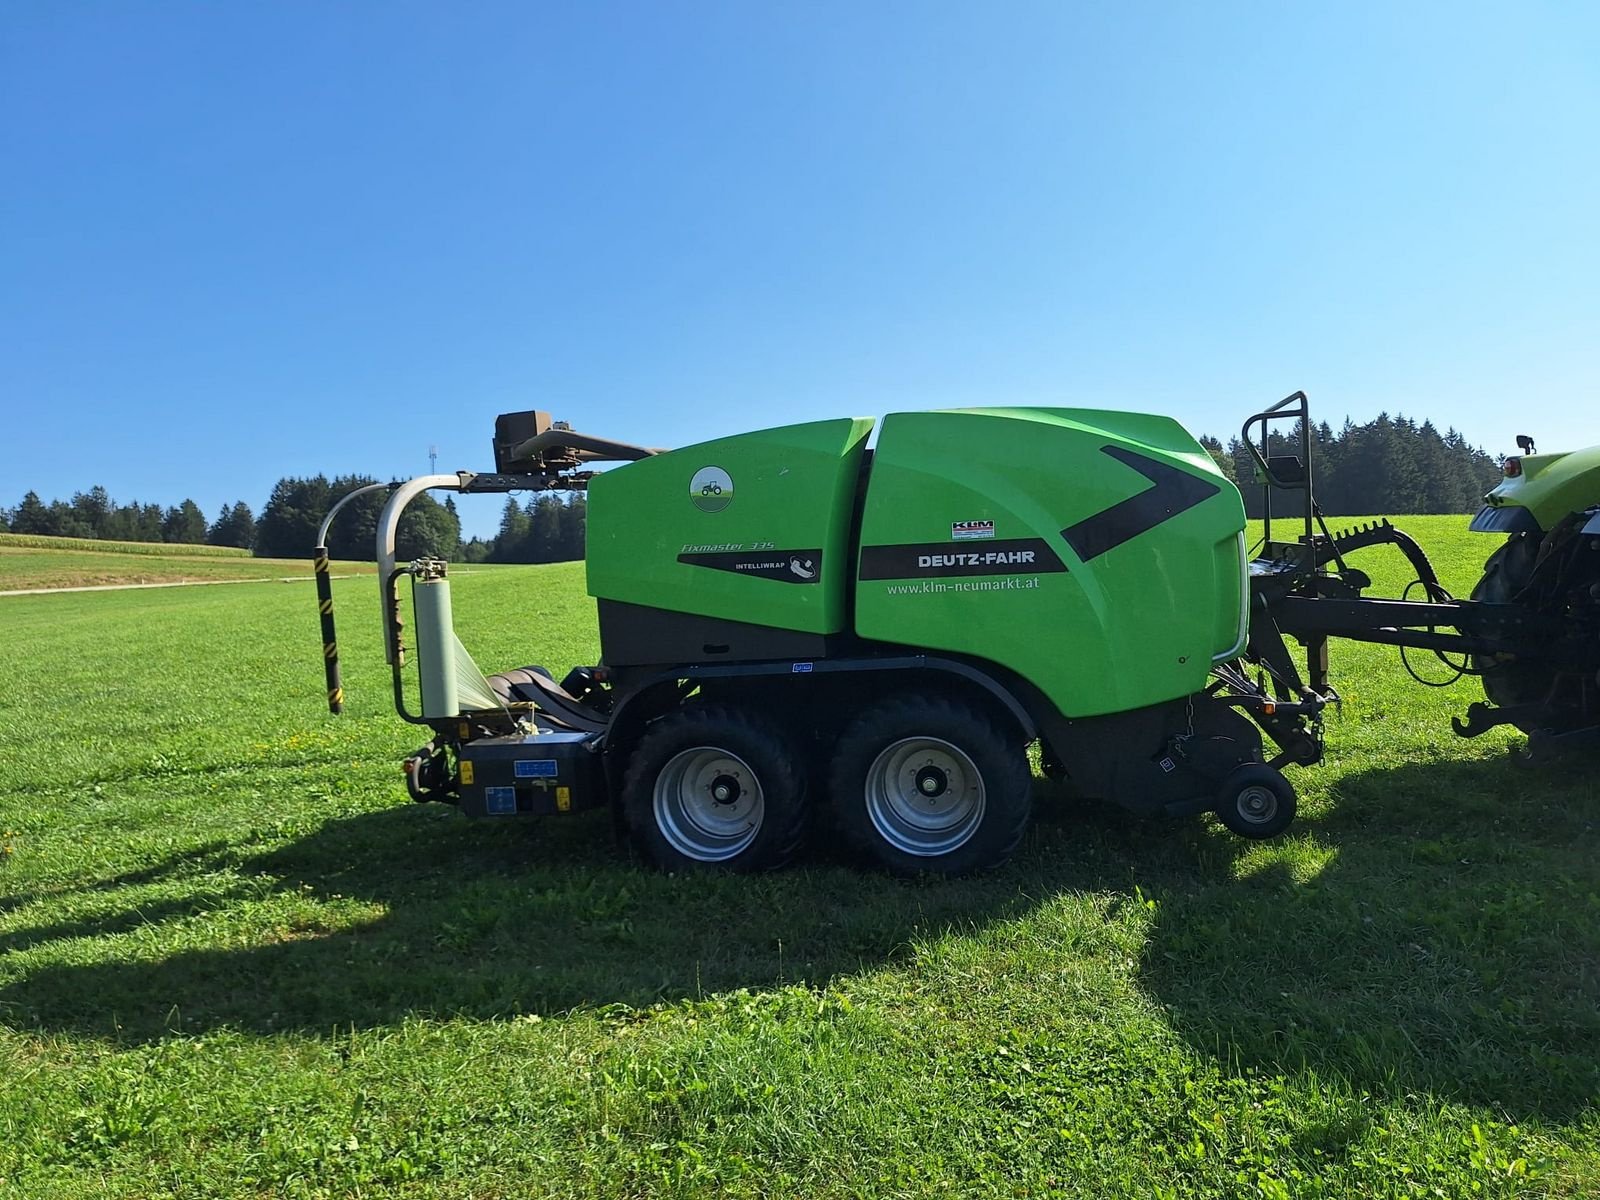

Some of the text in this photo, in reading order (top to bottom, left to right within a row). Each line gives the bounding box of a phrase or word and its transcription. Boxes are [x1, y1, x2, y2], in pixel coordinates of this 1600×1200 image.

[681, 542, 775, 552] Fixmaster 335
[735, 562, 786, 570] INTELLIWRAP
[918, 551, 1035, 568] DEUTZ-FAHR
[887, 576, 1040, 595] www.klm-neumarkt.at
